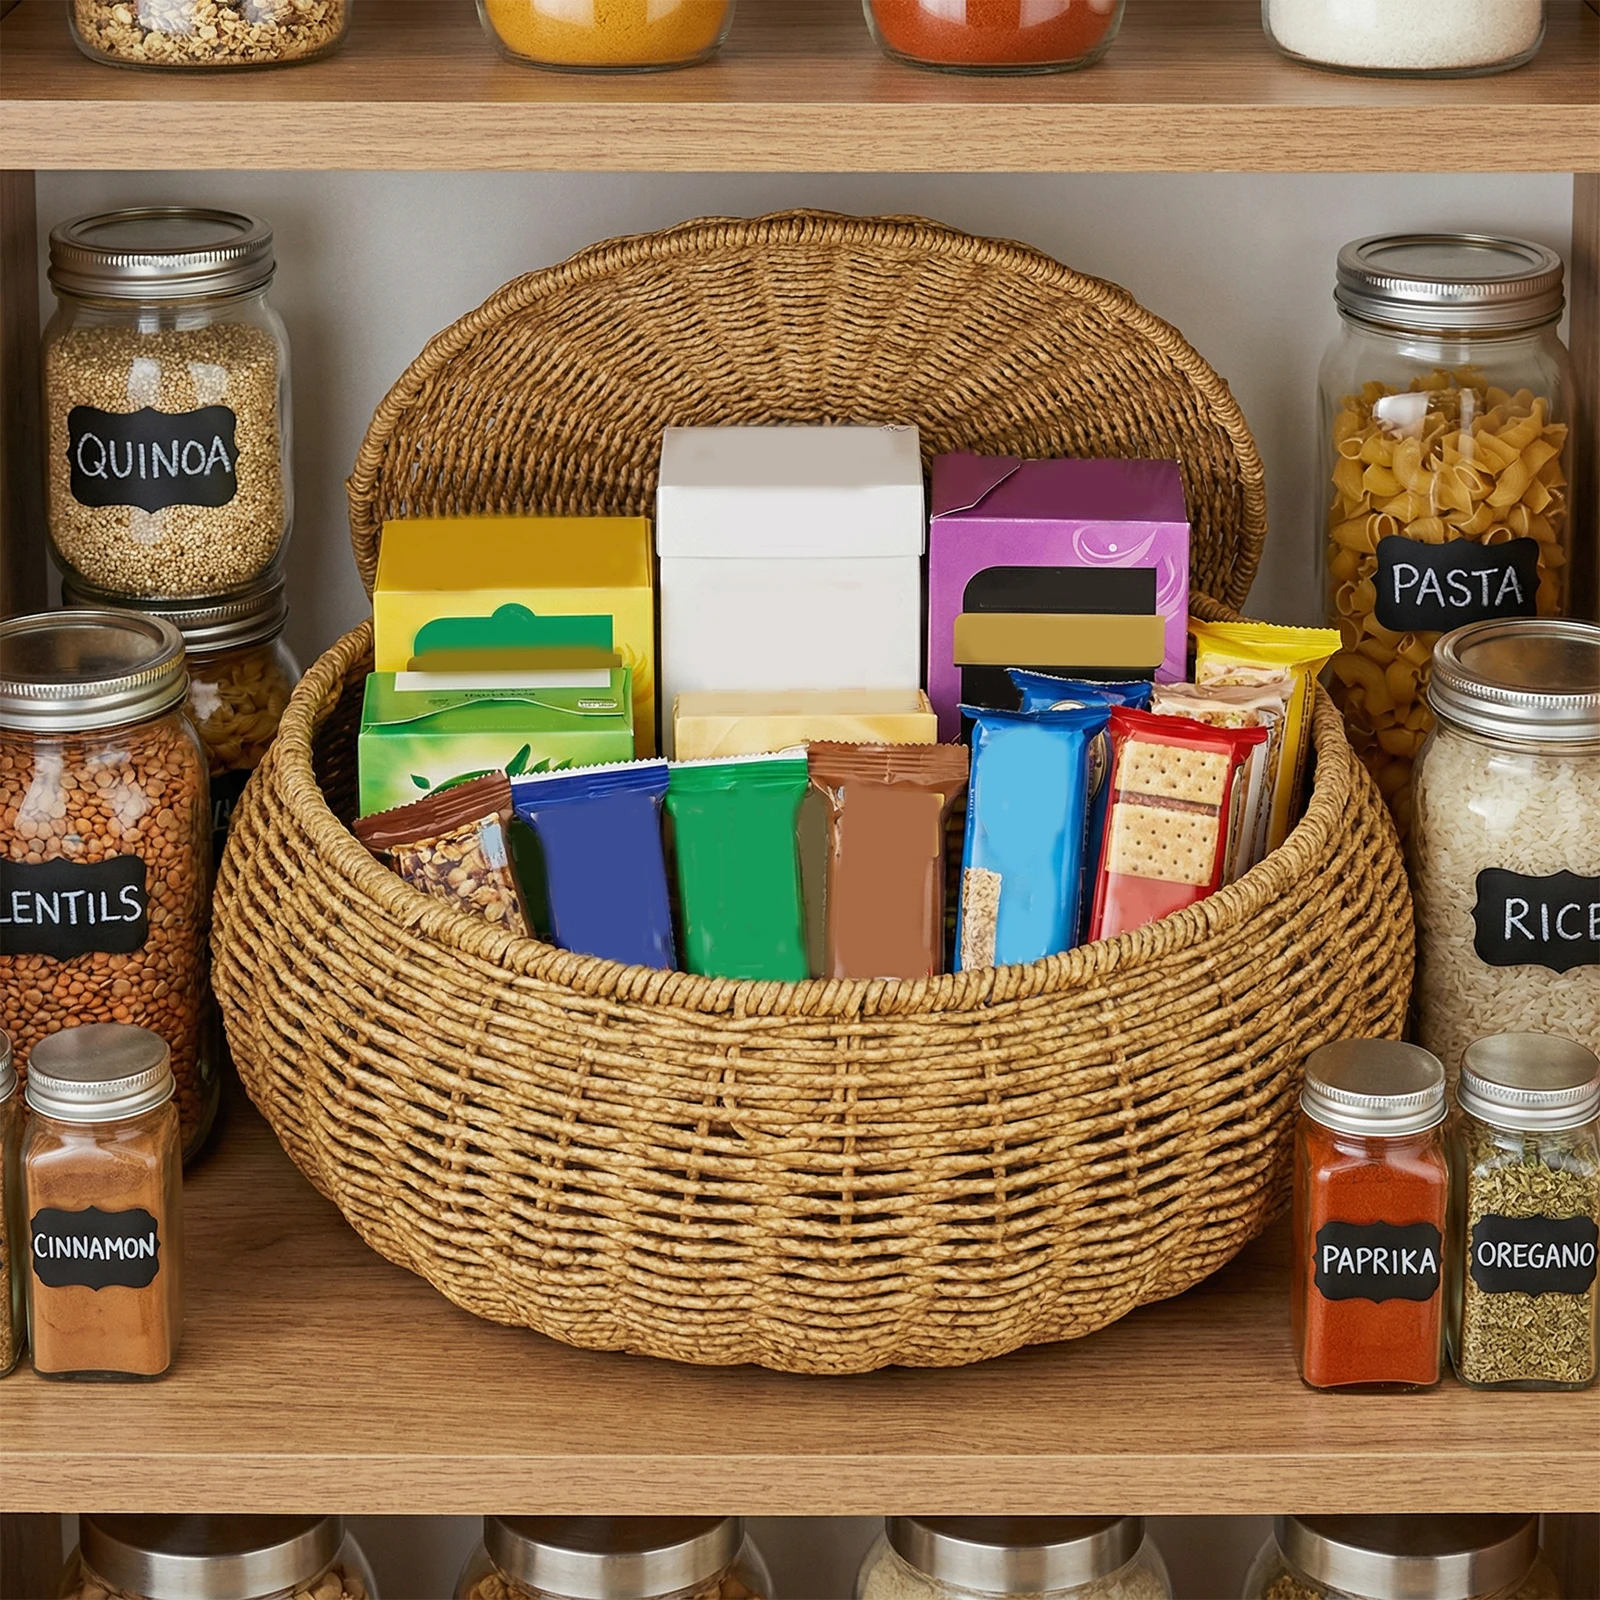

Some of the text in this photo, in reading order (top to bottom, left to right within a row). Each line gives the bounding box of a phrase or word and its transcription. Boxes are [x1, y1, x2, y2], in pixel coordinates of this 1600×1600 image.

[77, 432, 232, 480] QUINOA
[1392, 563, 1524, 608] PASTA
[34, 1232, 155, 1260] CINNAMON
[1322, 1244, 1437, 1275] PAPRIKA
[1477, 1241, 1595, 1269] OREGANO
